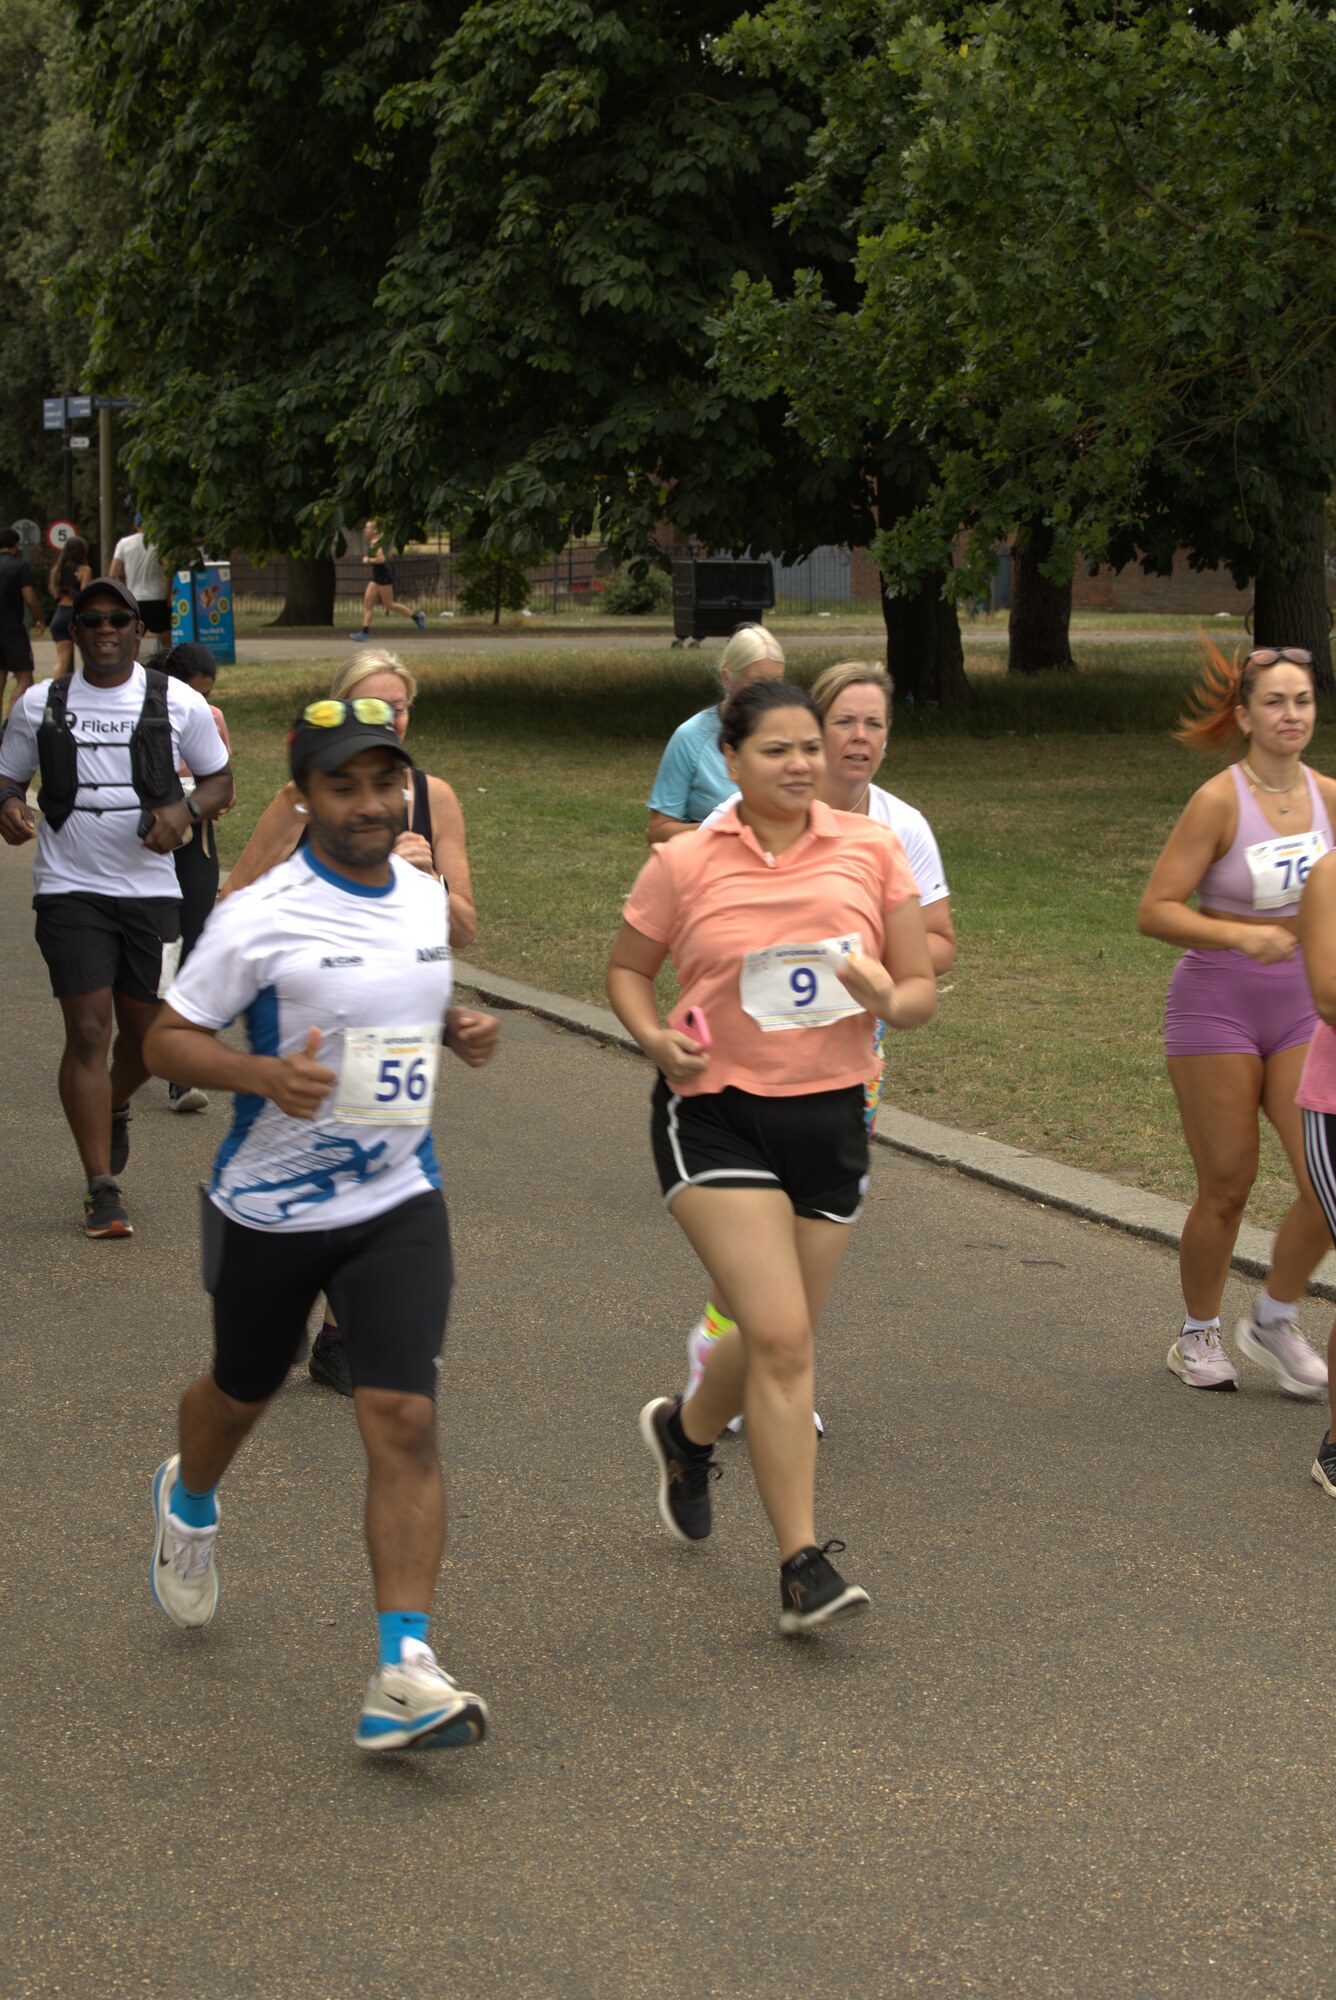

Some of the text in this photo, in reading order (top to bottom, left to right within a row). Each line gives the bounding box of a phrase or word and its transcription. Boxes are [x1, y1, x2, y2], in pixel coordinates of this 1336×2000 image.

[58, 529, 67, 542] 5
[1273, 855, 1312, 890] 76
[789, 967, 817, 1007] 9
[374, 1057, 428, 1103] 56
